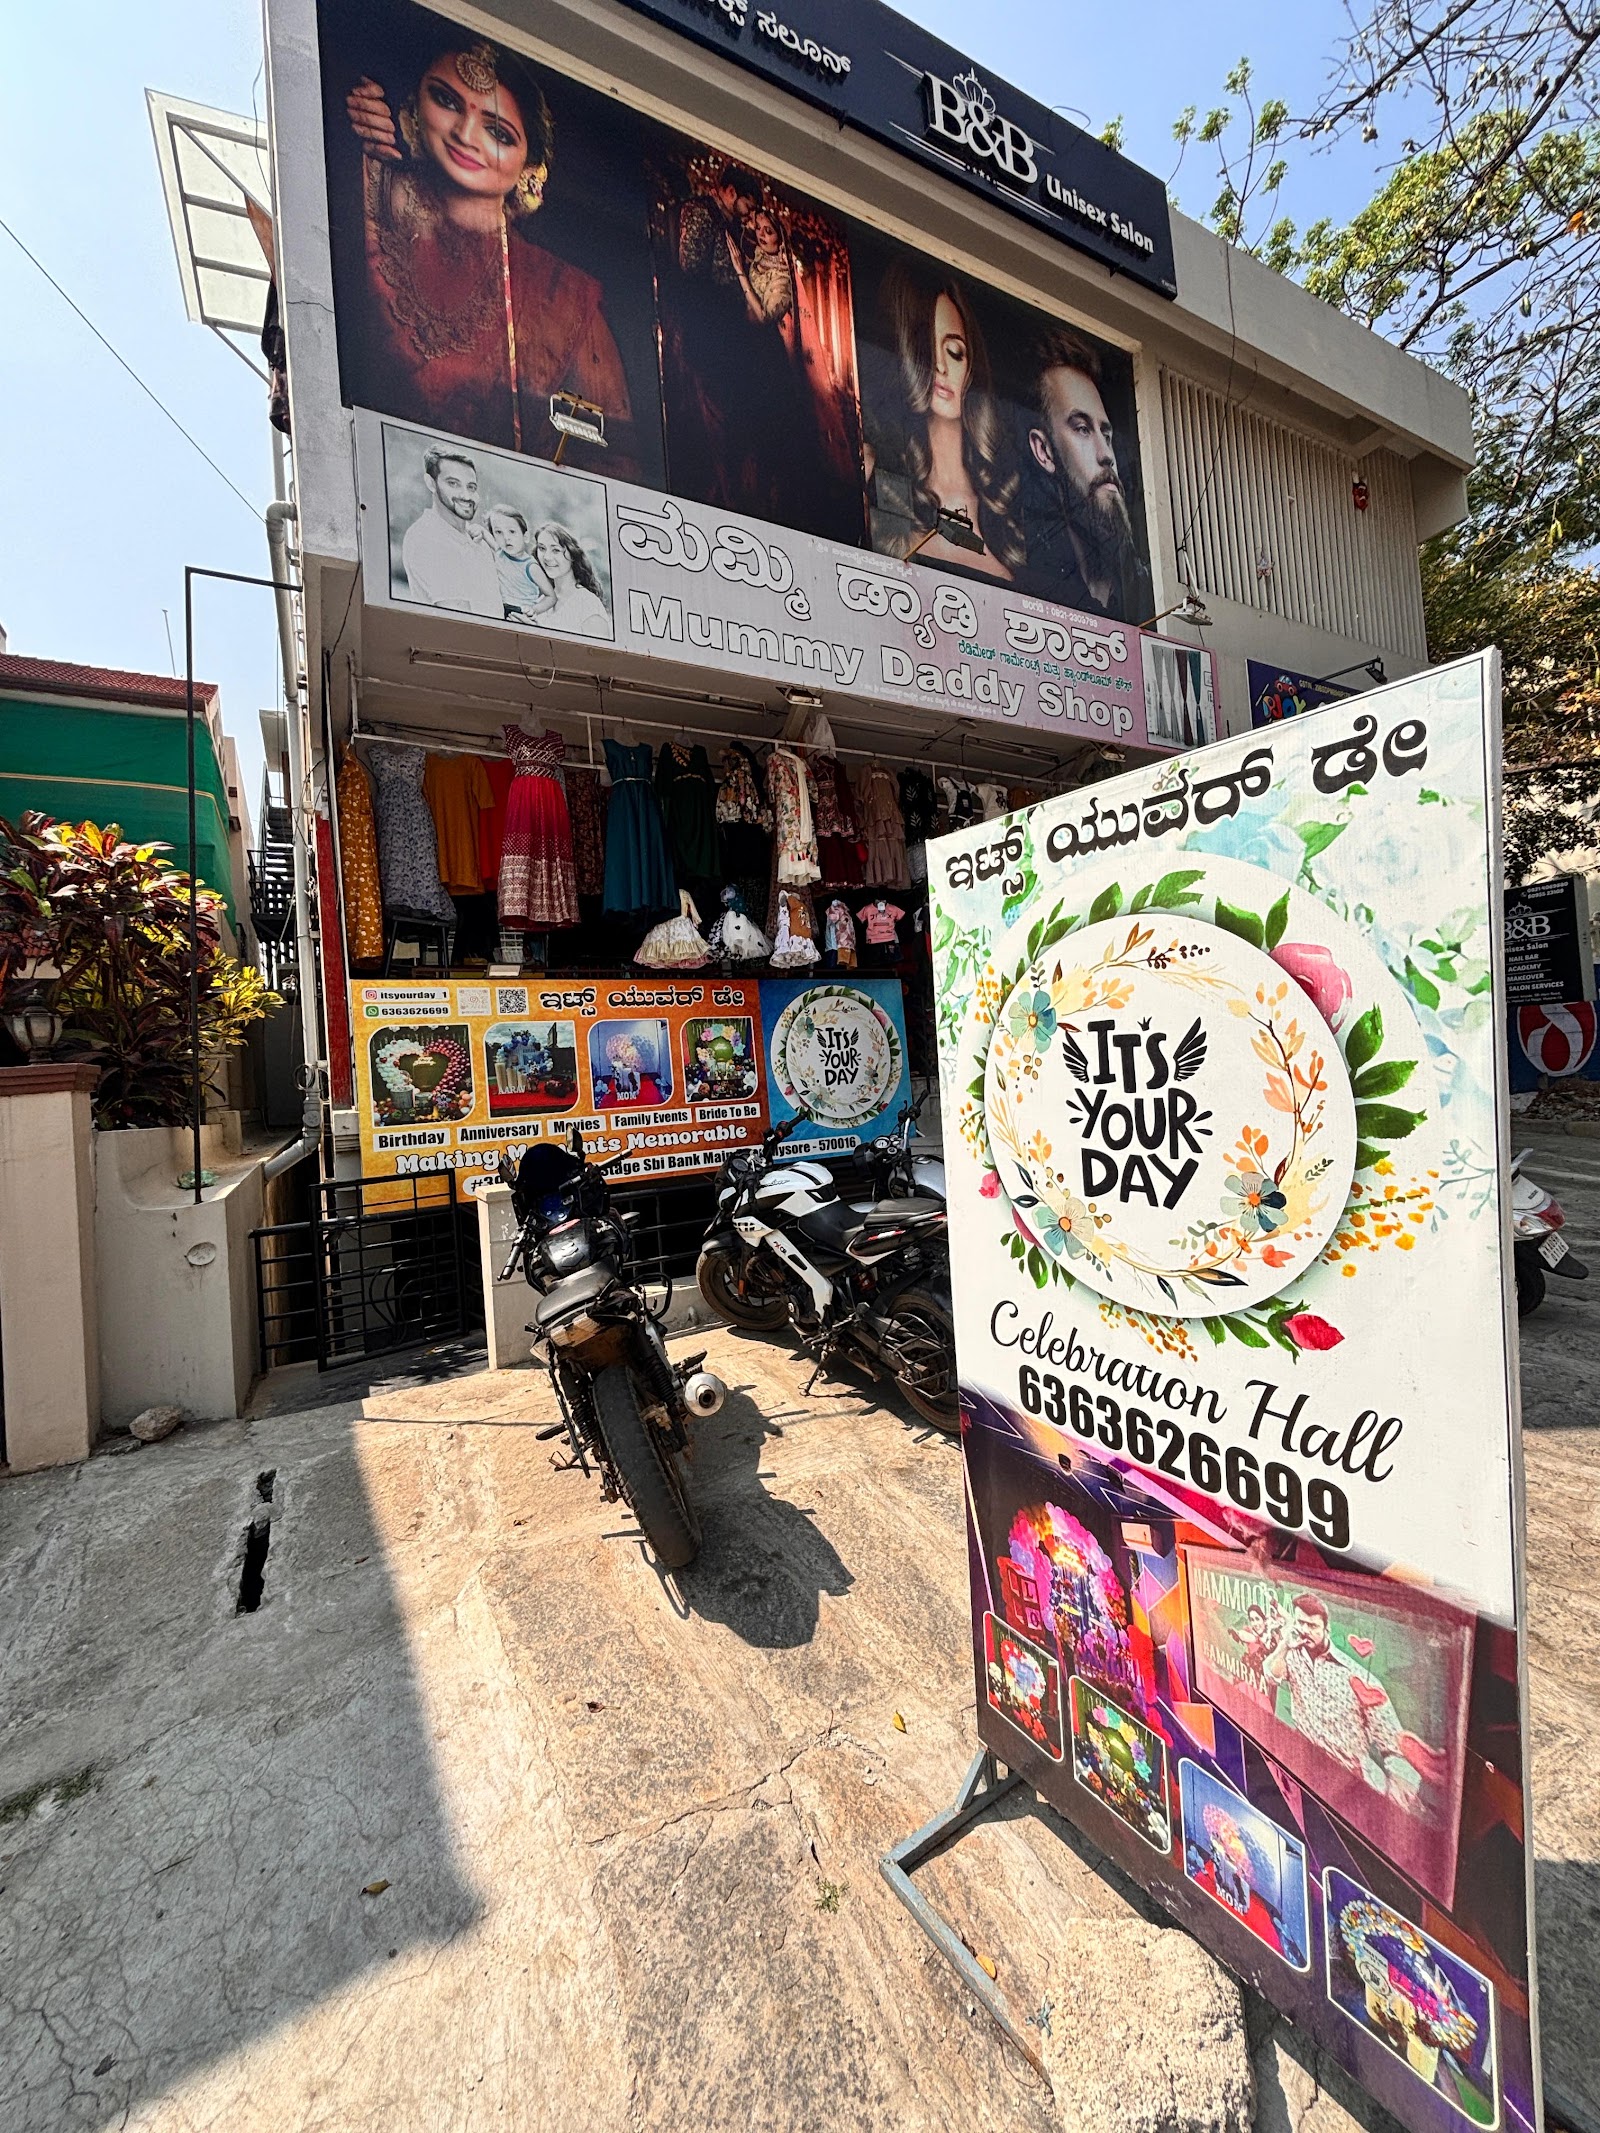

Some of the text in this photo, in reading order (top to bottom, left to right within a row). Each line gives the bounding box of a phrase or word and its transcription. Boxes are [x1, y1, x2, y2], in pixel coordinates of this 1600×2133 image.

[757, 10, 851, 74] ಸಲೂನ್
[924, 70, 1038, 184] B&B
[1046, 173, 1154, 253] Unisex Salon
[836, 563, 978, 648] ಡ್ಯಾಡಿ
[1004, 608, 1129, 671] ಶಾಪ್
[628, 588, 864, 686] Mummy
[881, 645, 1025, 717] Daddy
[1037, 680, 1134, 737] Shop
[1047, 745, 1274, 863] ಯುವರ್
[1311, 715, 1428, 794] ಡೇ
[1526, 942, 1549, 951] Salon
[1506, 973, 1544, 982] MAKEOVER
[1508, 963, 1541, 972] ACADEMY
[608, 985, 704, 1008] ಯುವರ್
[712, 985, 745, 1006] ಡೇ
[1531, 981, 1564, 990] SERVICES
[381, 1006, 449, 1016] 6363626699
[822, 1048, 859, 1069] YOUR
[825, 1067, 859, 1086] DAY
[614, 1110, 688, 1127] Family Events
[699, 1104, 757, 1120] Bride To Be
[1075, 1087, 1204, 1159] YOUR
[460, 1123, 539, 1142] Anniversary
[553, 1118, 601, 1133] Movies
[378, 1131, 445, 1149] Birthday
[396, 1149, 500, 1174] Making
[626, 1123, 748, 1151] Memorable
[643, 1155, 664, 1171] Sbi
[668, 1151, 700, 1169] Bank
[818, 1136, 856, 1151] 570016
[1081, 1147, 1199, 1210] DAY
[990, 1300, 1403, 1482] Celebration Hall
[1018, 1364, 1351, 1550] 6363626699
